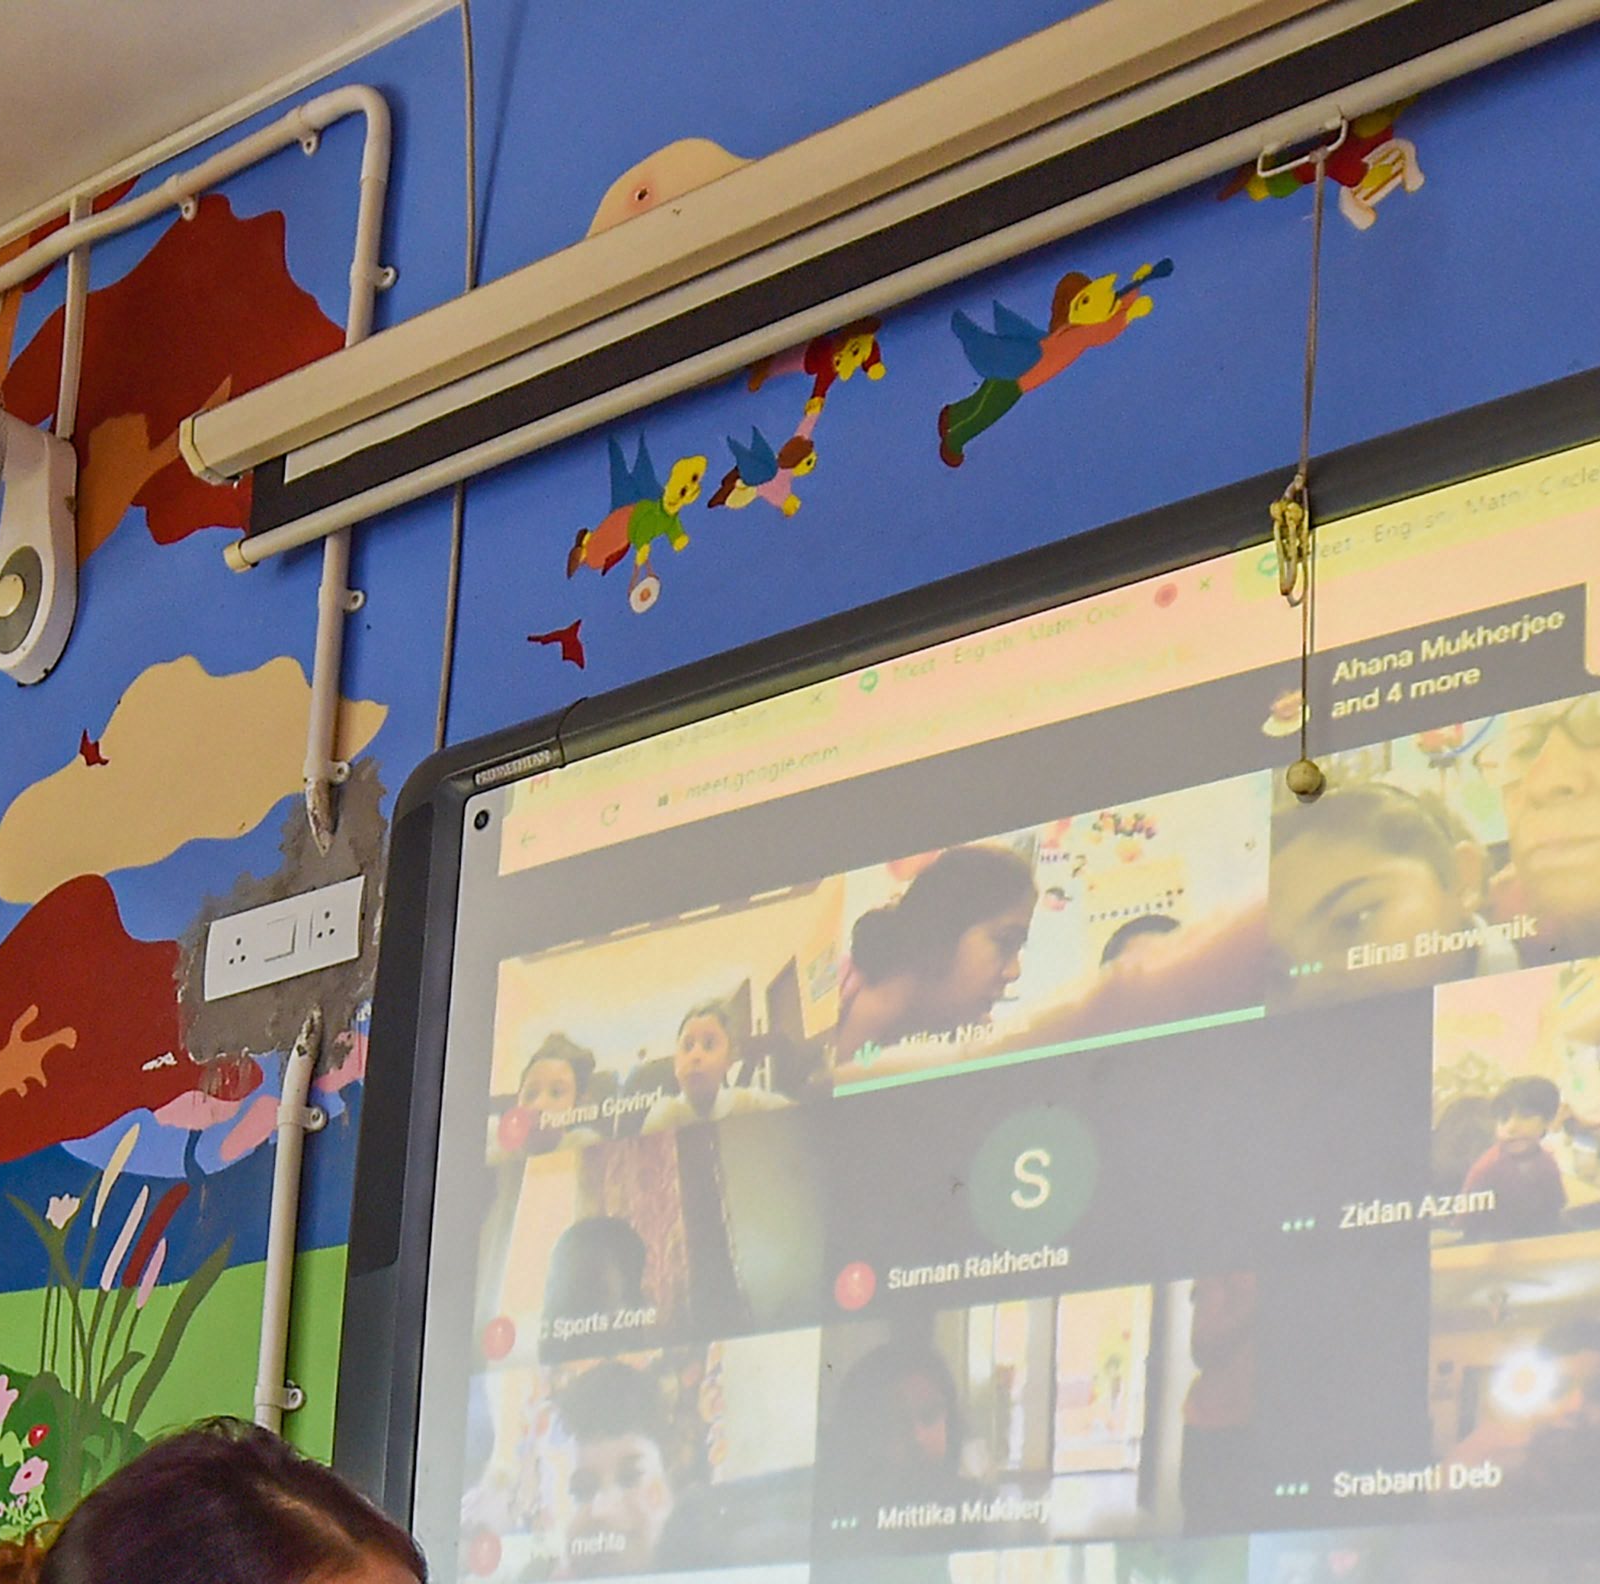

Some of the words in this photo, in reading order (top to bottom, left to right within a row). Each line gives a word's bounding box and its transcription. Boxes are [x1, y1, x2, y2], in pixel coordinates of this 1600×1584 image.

[1331, 647, 1414, 686] Ahana
[1418, 607, 1566, 660] Mukherjee
[1330, 691, 1380, 720] and
[1386, 683, 1403, 709] 4
[1408, 663, 1482, 700] more
[684, 745, 840, 800] meet.google.com
[1346, 930, 1408, 972] Elina
[539, 1102, 599, 1131] Padma
[1009, 1148, 1052, 1210] S
[1337, 1198, 1413, 1231] Zidan
[1417, 1188, 1497, 1219] Azam
[888, 1257, 960, 1291] Suman
[964, 1242, 1069, 1280] Rakhecha
[551, 1311, 609, 1341] Sports
[612, 1305, 658, 1331] Zone
[1333, 1464, 1443, 1499] Srabanti
[1448, 1461, 1502, 1490] Deb
[876, 1503, 956, 1530] Mrittika
